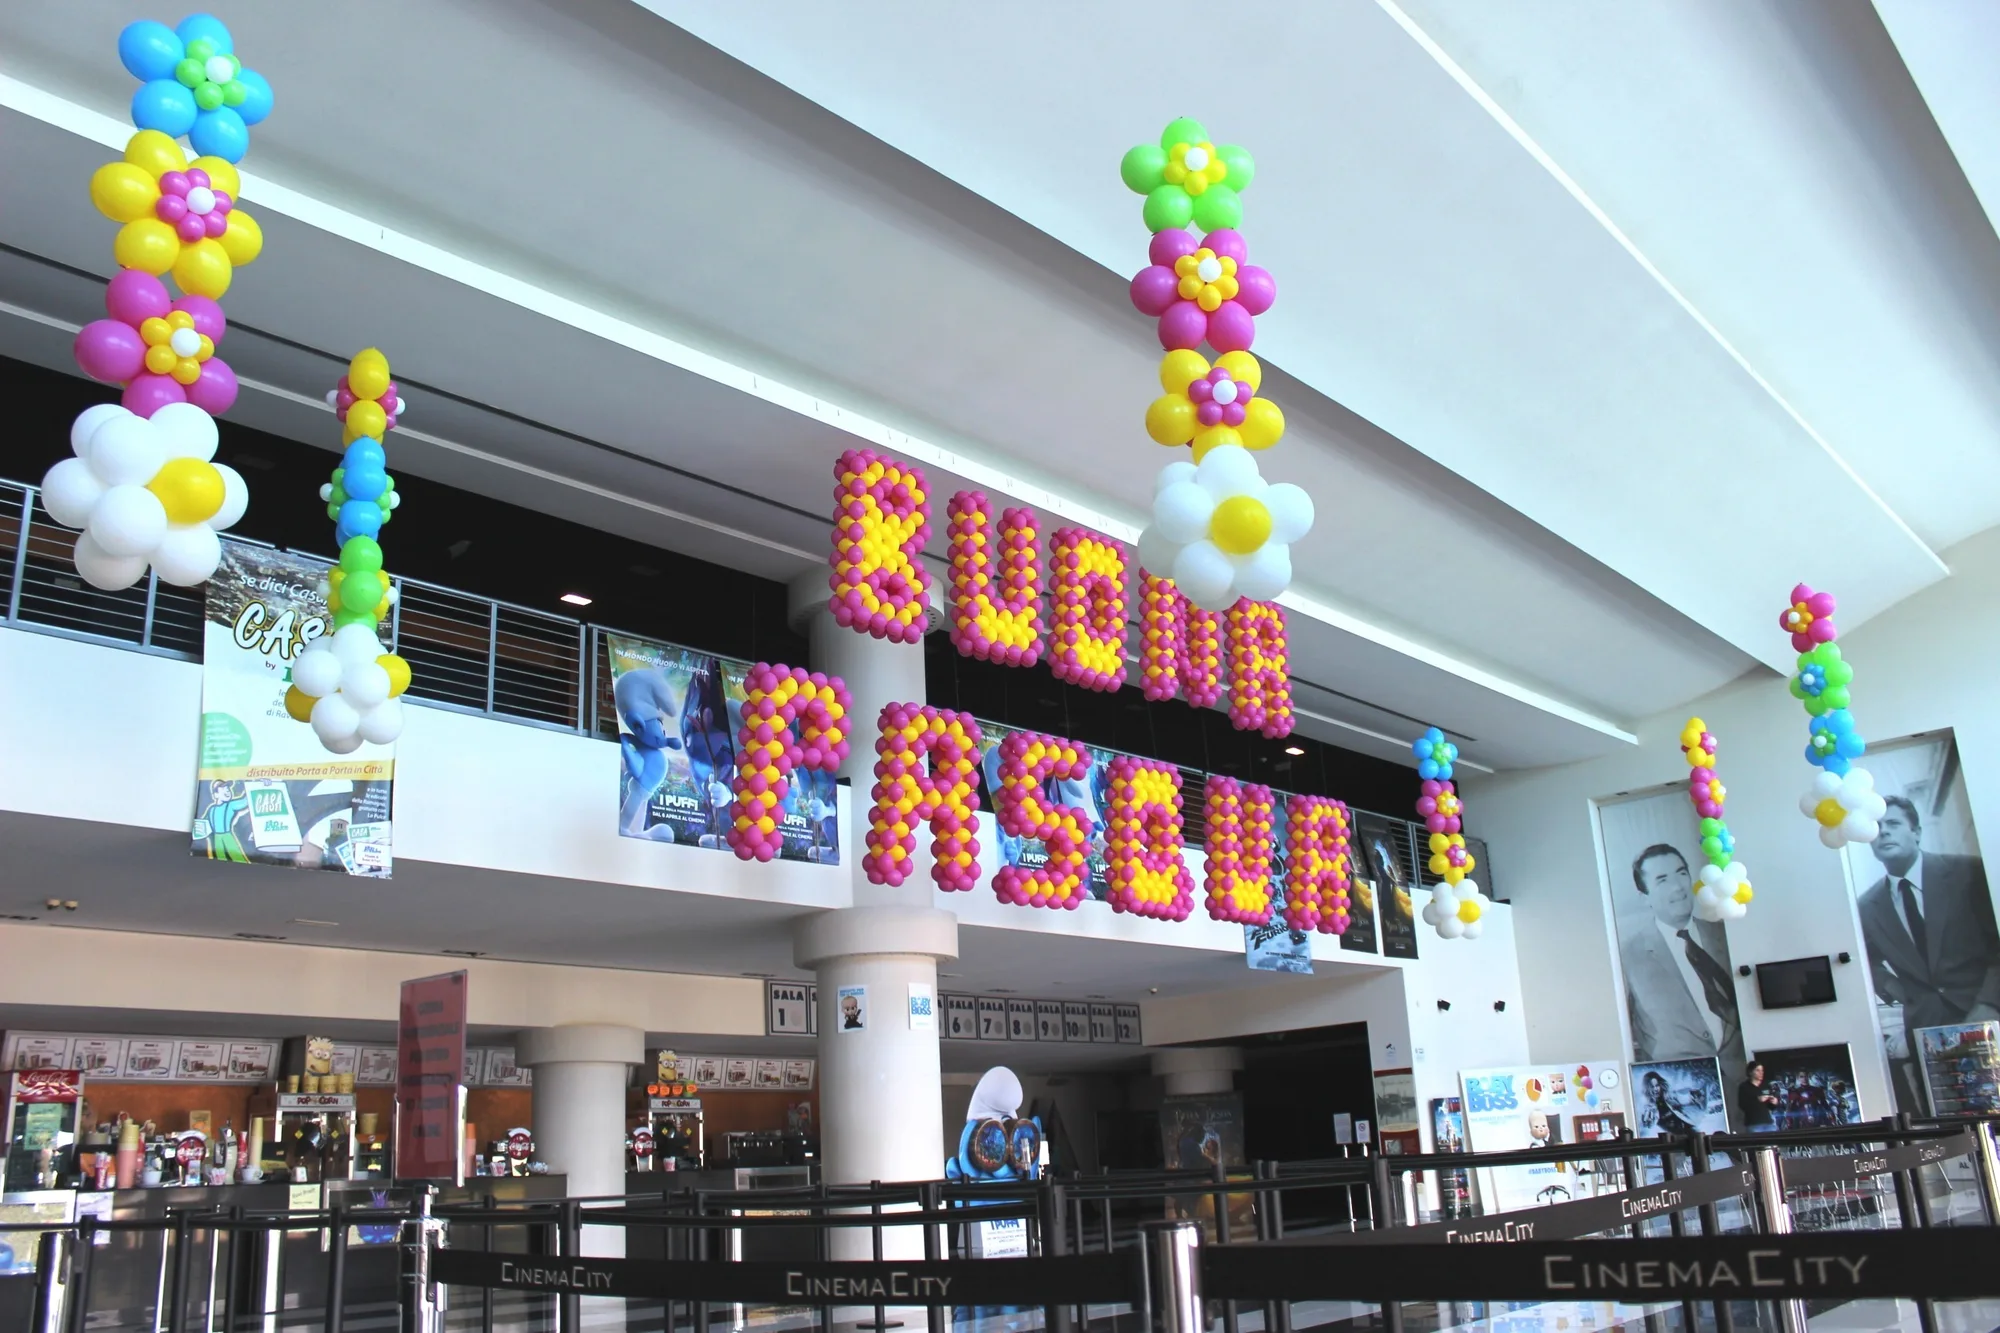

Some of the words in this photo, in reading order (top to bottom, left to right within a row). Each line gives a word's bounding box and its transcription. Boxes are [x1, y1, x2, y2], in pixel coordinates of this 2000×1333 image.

[241, 574, 256, 587] se
[259, 577, 287, 594] dici
[829, 448, 1295, 738] BUONA
[233, 601, 328, 660] CAS
[265, 660, 276, 670] by
[614, 648, 624, 657] UN
[624, 651, 652, 662] MONDO
[652, 657, 678, 669] NUOVO
[246, 767, 294, 777] distribuito
[296, 766, 320, 776] Porta
[330, 766, 352, 774] Porta
[354, 765, 362, 774] in
[255, 793, 282, 813] CASA
[660, 794, 664, 805] I
[665, 794, 699, 811] PUFFI
[727, 662, 1350, 934] PASQUA
[783, 813, 807, 828] UFFI
[773, 989, 804, 1001] SALA
[911, 1006, 932, 1016] BOSS
[949, 1001, 974, 1010] SALA
[980, 1002, 1004, 1011] SALA
[1010, 1003, 1033, 1013] SALA
[1038, 1004, 1060, 1014] SALA
[1065, 1005, 1087, 1016] SALA
[1091, 1006, 1112, 1017] SALA
[1117, 1008, 1137, 1018] SALA
[778, 1008, 785, 1026] 1
[952, 1017, 961, 1034] 6
[983, 1018, 992, 1034] 7
[1013, 1020, 1021, 1035] 8
[1041, 1021, 1049, 1036] 9
[1066, 1021, 1079, 1037] 10
[1092, 1022, 1104, 1038] 11
[1118, 1024, 1130, 1038] 12
[297, 1096, 311, 1105] POP
[318, 1095, 338, 1105] CORN
[661, 1099, 671, 1108] POP
[676, 1099, 690, 1108] CORN
[1467, 1091, 1519, 1113] BOSS
